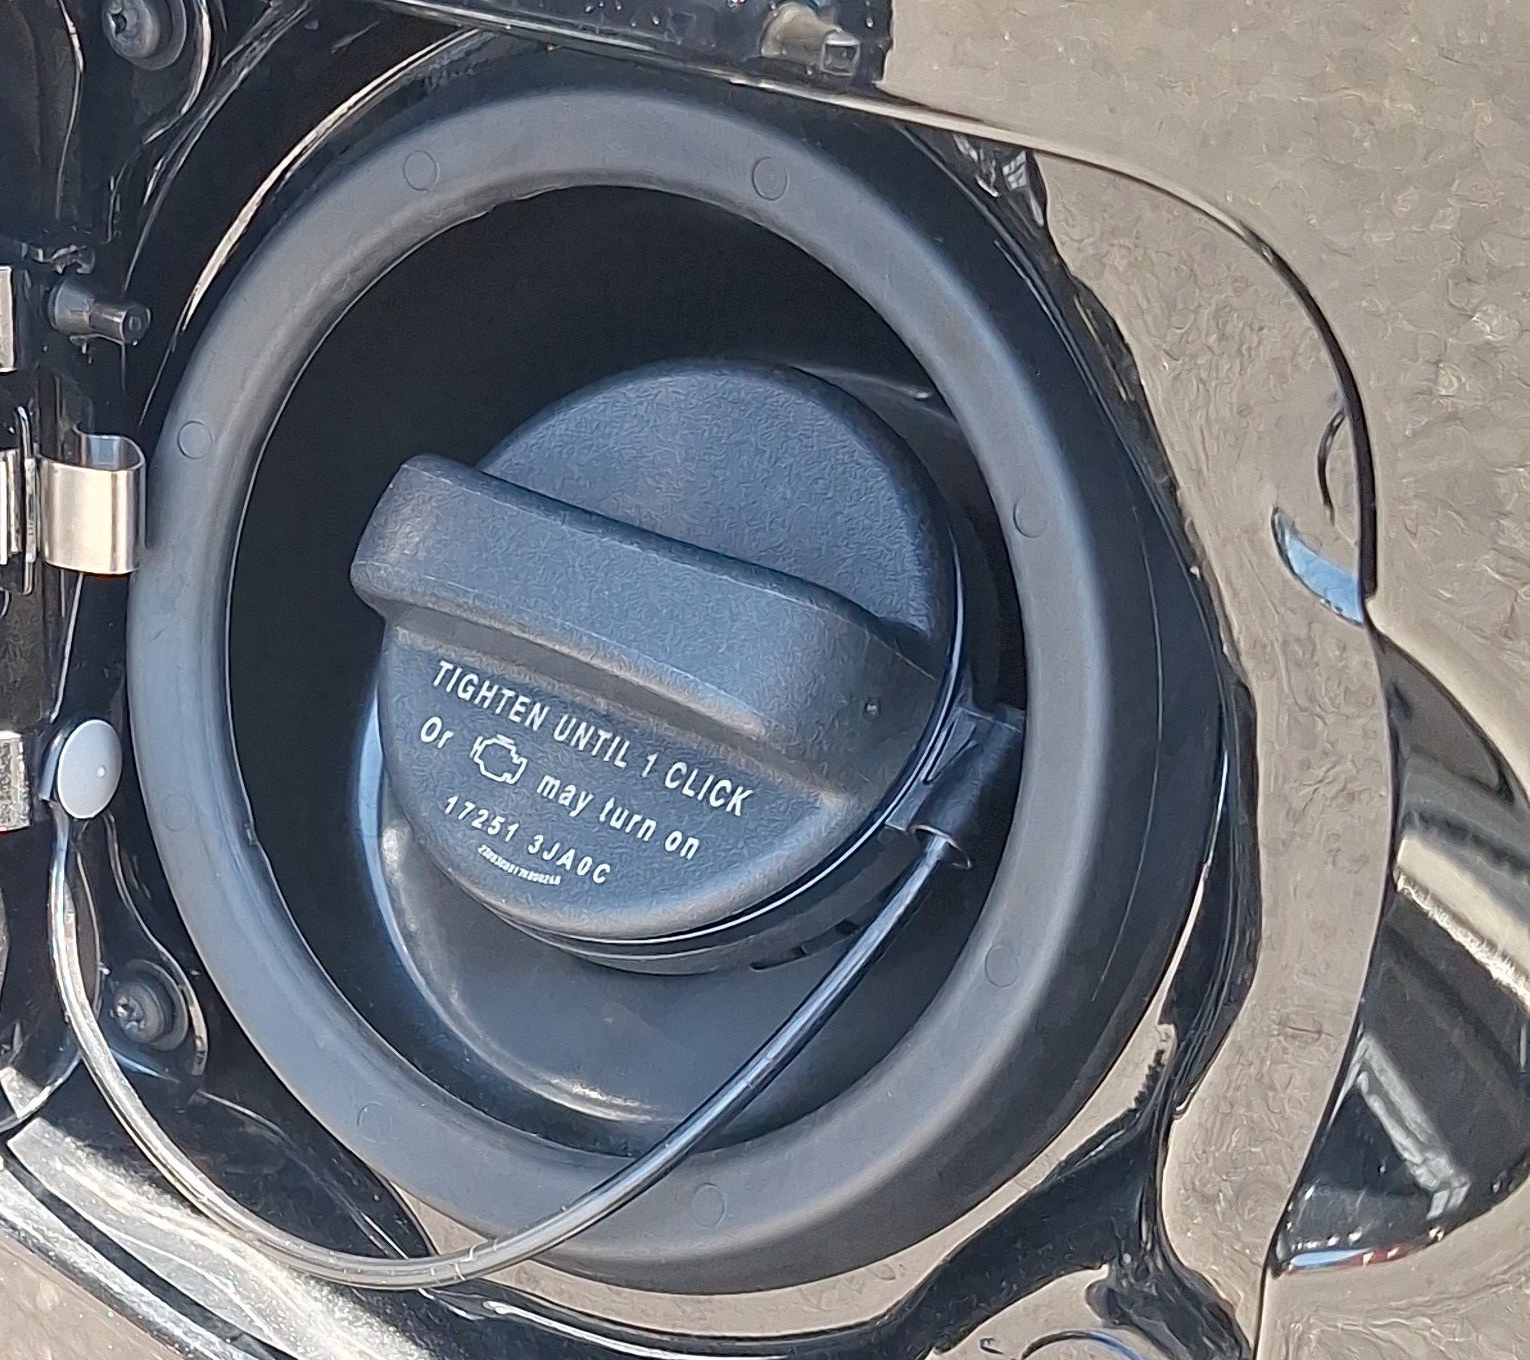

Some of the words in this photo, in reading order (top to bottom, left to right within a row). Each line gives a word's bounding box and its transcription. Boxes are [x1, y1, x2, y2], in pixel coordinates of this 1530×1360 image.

[420, 717, 455, 748] Or
[536, 775, 594, 817] may
[599, 798, 658, 842] turn
[664, 831, 701, 860] on
[432, 660, 552, 731] TIGHTEN
[553, 715, 630, 768] UNTIL
[642, 752, 658, 778] 1
[664, 762, 754, 816] CLICK
[444, 796, 518, 843] 17251
